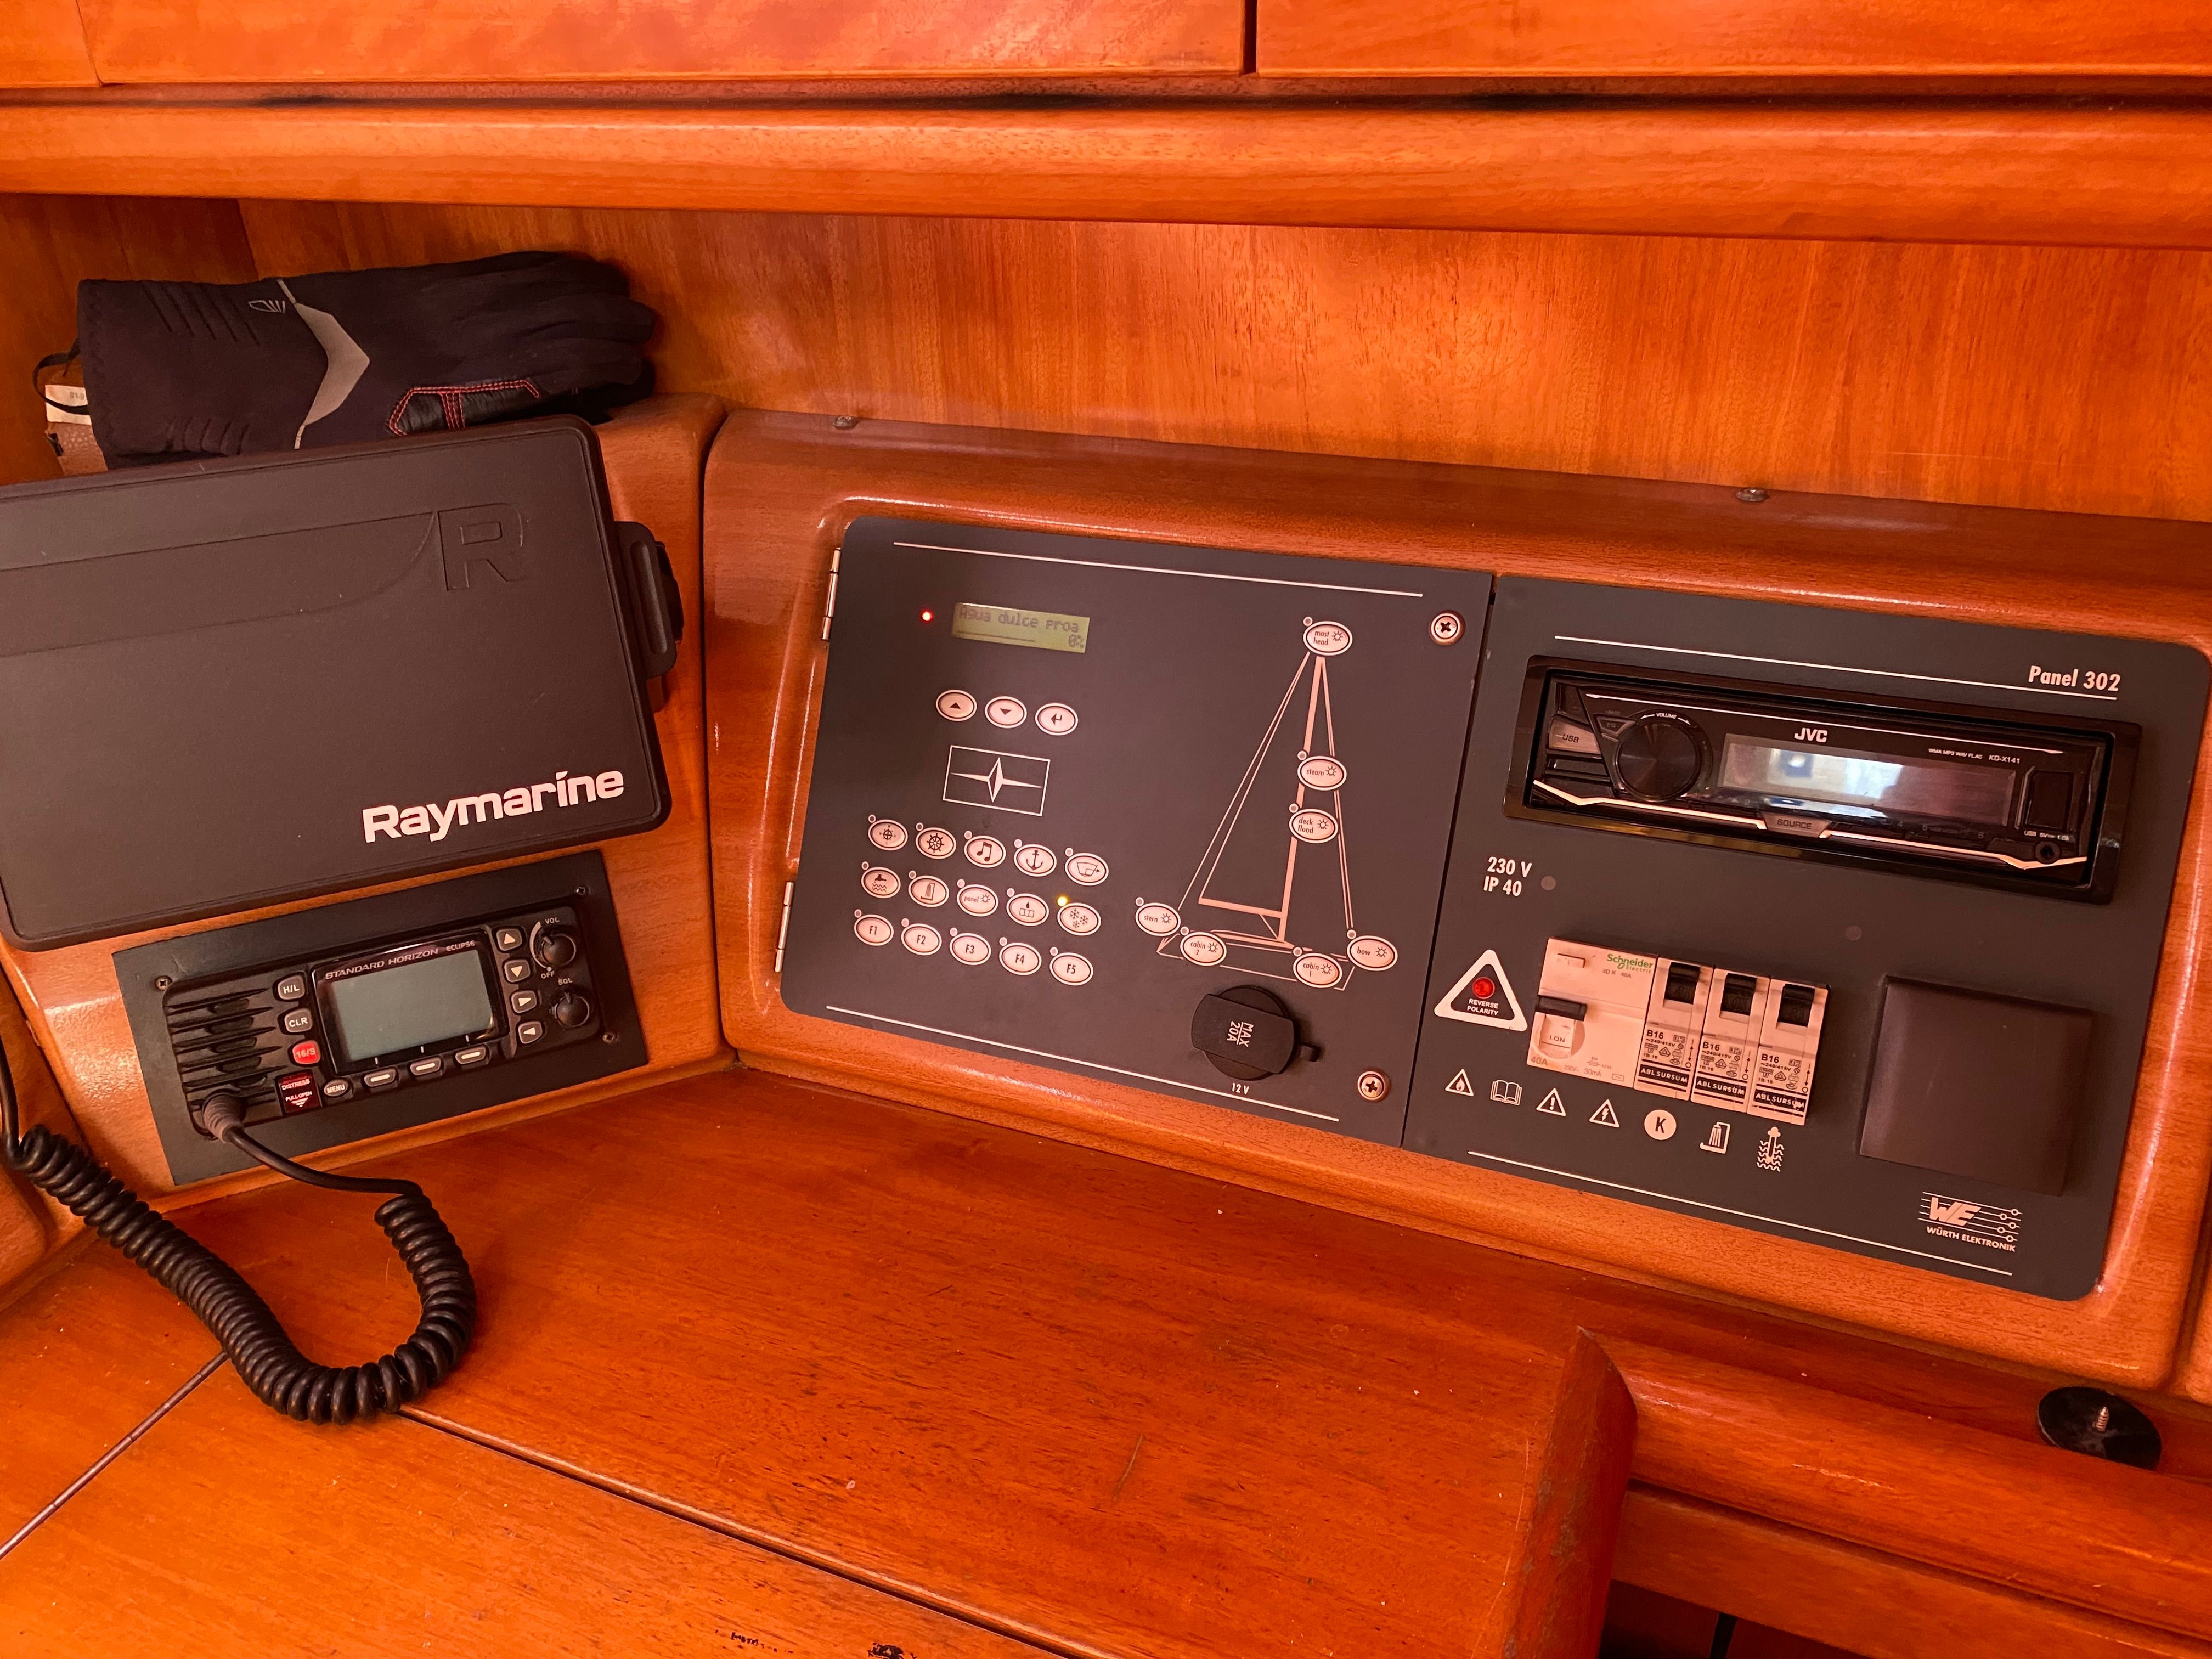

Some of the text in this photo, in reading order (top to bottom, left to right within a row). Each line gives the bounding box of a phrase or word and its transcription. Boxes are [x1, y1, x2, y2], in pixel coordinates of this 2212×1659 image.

[998, 611, 1038, 628] dulce
[1045, 618, 1079, 633] proa
[1313, 637, 1329, 646] head
[2028, 665, 2121, 692] Panel 302
[1562, 733, 1579, 743] USB
[1794, 727, 1828, 743] JVC
[1989, 754, 2021, 764] KD-X141
[1306, 768, 1324, 777] steam
[362, 770, 624, 843] Raymarine
[1298, 816, 1313, 826] deck
[1777, 819, 1812, 830] SOURCE
[1297, 825, 1314, 834] flood
[1487, 856, 1532, 878] 230 V
[1483, 876, 1522, 896] IP 40
[964, 895, 979, 904] panel
[1144, 915, 1158, 923] stern
[870, 925, 877, 935] F1
[917, 934, 926, 945] F2
[1190, 940, 1206, 950] cabin
[965, 944, 975, 955] F3
[1357, 946, 1371, 956] bow
[325, 940, 476, 980] STANDARD HORIZON ECLIPSE
[1015, 954, 1025, 964] F4
[1606, 953, 1654, 969] Schneider
[1066, 964, 1076, 974] F5
[1303, 962, 1319, 972] cabin
[1626, 965, 1652, 974] Electric
[540, 970, 555, 979] OFF
[283, 984, 300, 994] H/L
[1469, 998, 1499, 1009] REVERSE
[1466, 1005, 1499, 1016] POLARITY
[289, 1017, 308, 1028] CLR
[1226, 1020, 1241, 1042] 20A
[1238, 1022, 1254, 1048] MAX
[1646, 1029, 1664, 1040] B16
[1702, 1041, 1720, 1051] B16
[296, 1047, 316, 1059] 16/S
[1761, 1053, 1779, 1064] B16
[1530, 1056, 1548, 1066] 40A
[1584, 1068, 1601, 1077] 30mA
[1640, 1068, 1688, 1084] ABL SURSUM
[281, 1078, 311, 1091] DISTRESS
[326, 1084, 346, 1094] MENU
[1232, 1082, 1250, 1095] 12 V
[1696, 1080, 1745, 1095] ABL SURSUM
[1755, 1092, 1770, 1101] ABL
[1656, 1117, 1665, 1133] K
[1929, 1196, 1982, 1226] WE
[1926, 1226, 2016, 1252] WÜRTH ELEKTRONIK
